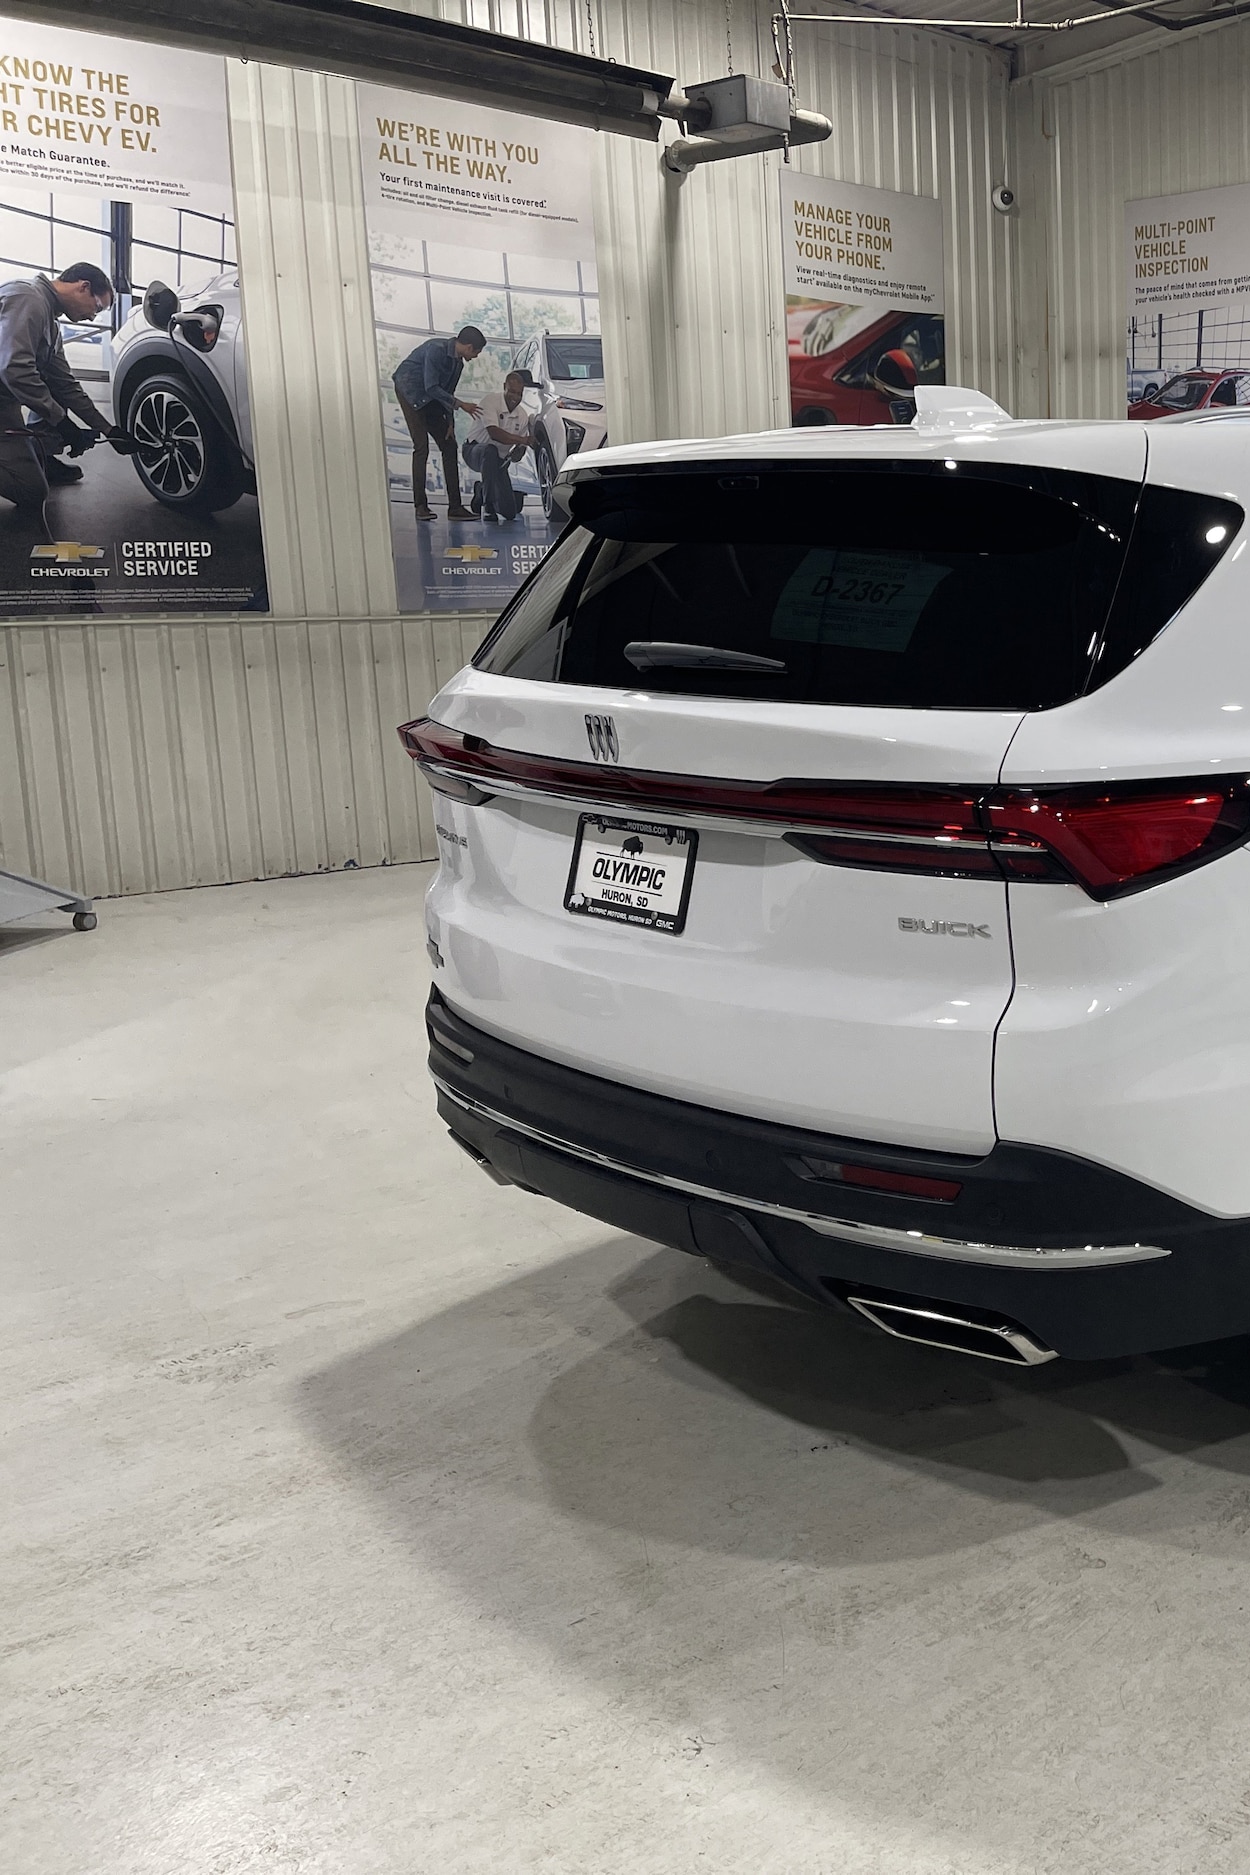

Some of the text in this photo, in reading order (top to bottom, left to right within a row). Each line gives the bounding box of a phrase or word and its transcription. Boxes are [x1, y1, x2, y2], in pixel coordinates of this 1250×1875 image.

[0, 56, 129, 95] KNOW THE
[32, 87, 105, 119] TIRES
[115, 102, 160, 127] FOR
[28, 114, 112, 146] CHEVY
[121, 130, 157, 153] EV.
[376, 118, 539, 165] WE'RE WITH YOU
[11, 145, 46, 159] Match
[49, 150, 110, 168] Guarantee.
[379, 143, 512, 184] ALL THE WAY.
[380, 172, 401, 184] Your
[403, 177, 423, 188] first
[426, 183, 481, 199] maintenance
[482, 192, 501, 202] visit
[503, 194, 509, 203] is
[794, 200, 891, 233] MANAGE YOUR
[794, 220, 892, 253] VEHICLE FROM
[1135, 217, 1216, 241] MULTI-POINT
[796, 241, 886, 271] YOUR PHONE.
[1135, 240, 1186, 260] VEHICLE
[796, 265, 927, 292] View real-time diagnostics and enjoy remote
[1135, 256, 1209, 279] INSPECTION
[816, 279, 842, 291] available
[844, 284, 851, 292] on
[853, 284, 863, 294] the
[864, 287, 900, 299] myChevrolet
[902, 291, 920, 301] Mobile
[1135, 287, 1145, 295] The
[1146, 285, 1162, 295] peace
[1164, 283, 1170, 291] of
[1171, 282, 1185, 291] mind
[1186, 282, 1198, 290] that
[1199, 280, 1217, 289] comes
[1218, 278, 1232, 286] from
[1135, 297, 1148, 306] your
[1149, 294, 1172, 303] vehicle's
[1173, 291, 1191, 300] health
[1192, 289, 1216, 299] checked
[1217, 288, 1230, 296] with
[122, 542, 212, 558] CERTIFIED
[30, 568, 110, 577] CHEVROLET
[124, 560, 199, 576] SERVICE
[442, 567, 502, 575] CHEVROLET
[811, 576, 905, 605] D-2367
[592, 858, 666, 890] OLYMPIC
[602, 888, 649, 908] HURON, SD
[656, 919, 675, 930] GMC
[898, 917, 992, 939] BUICK
